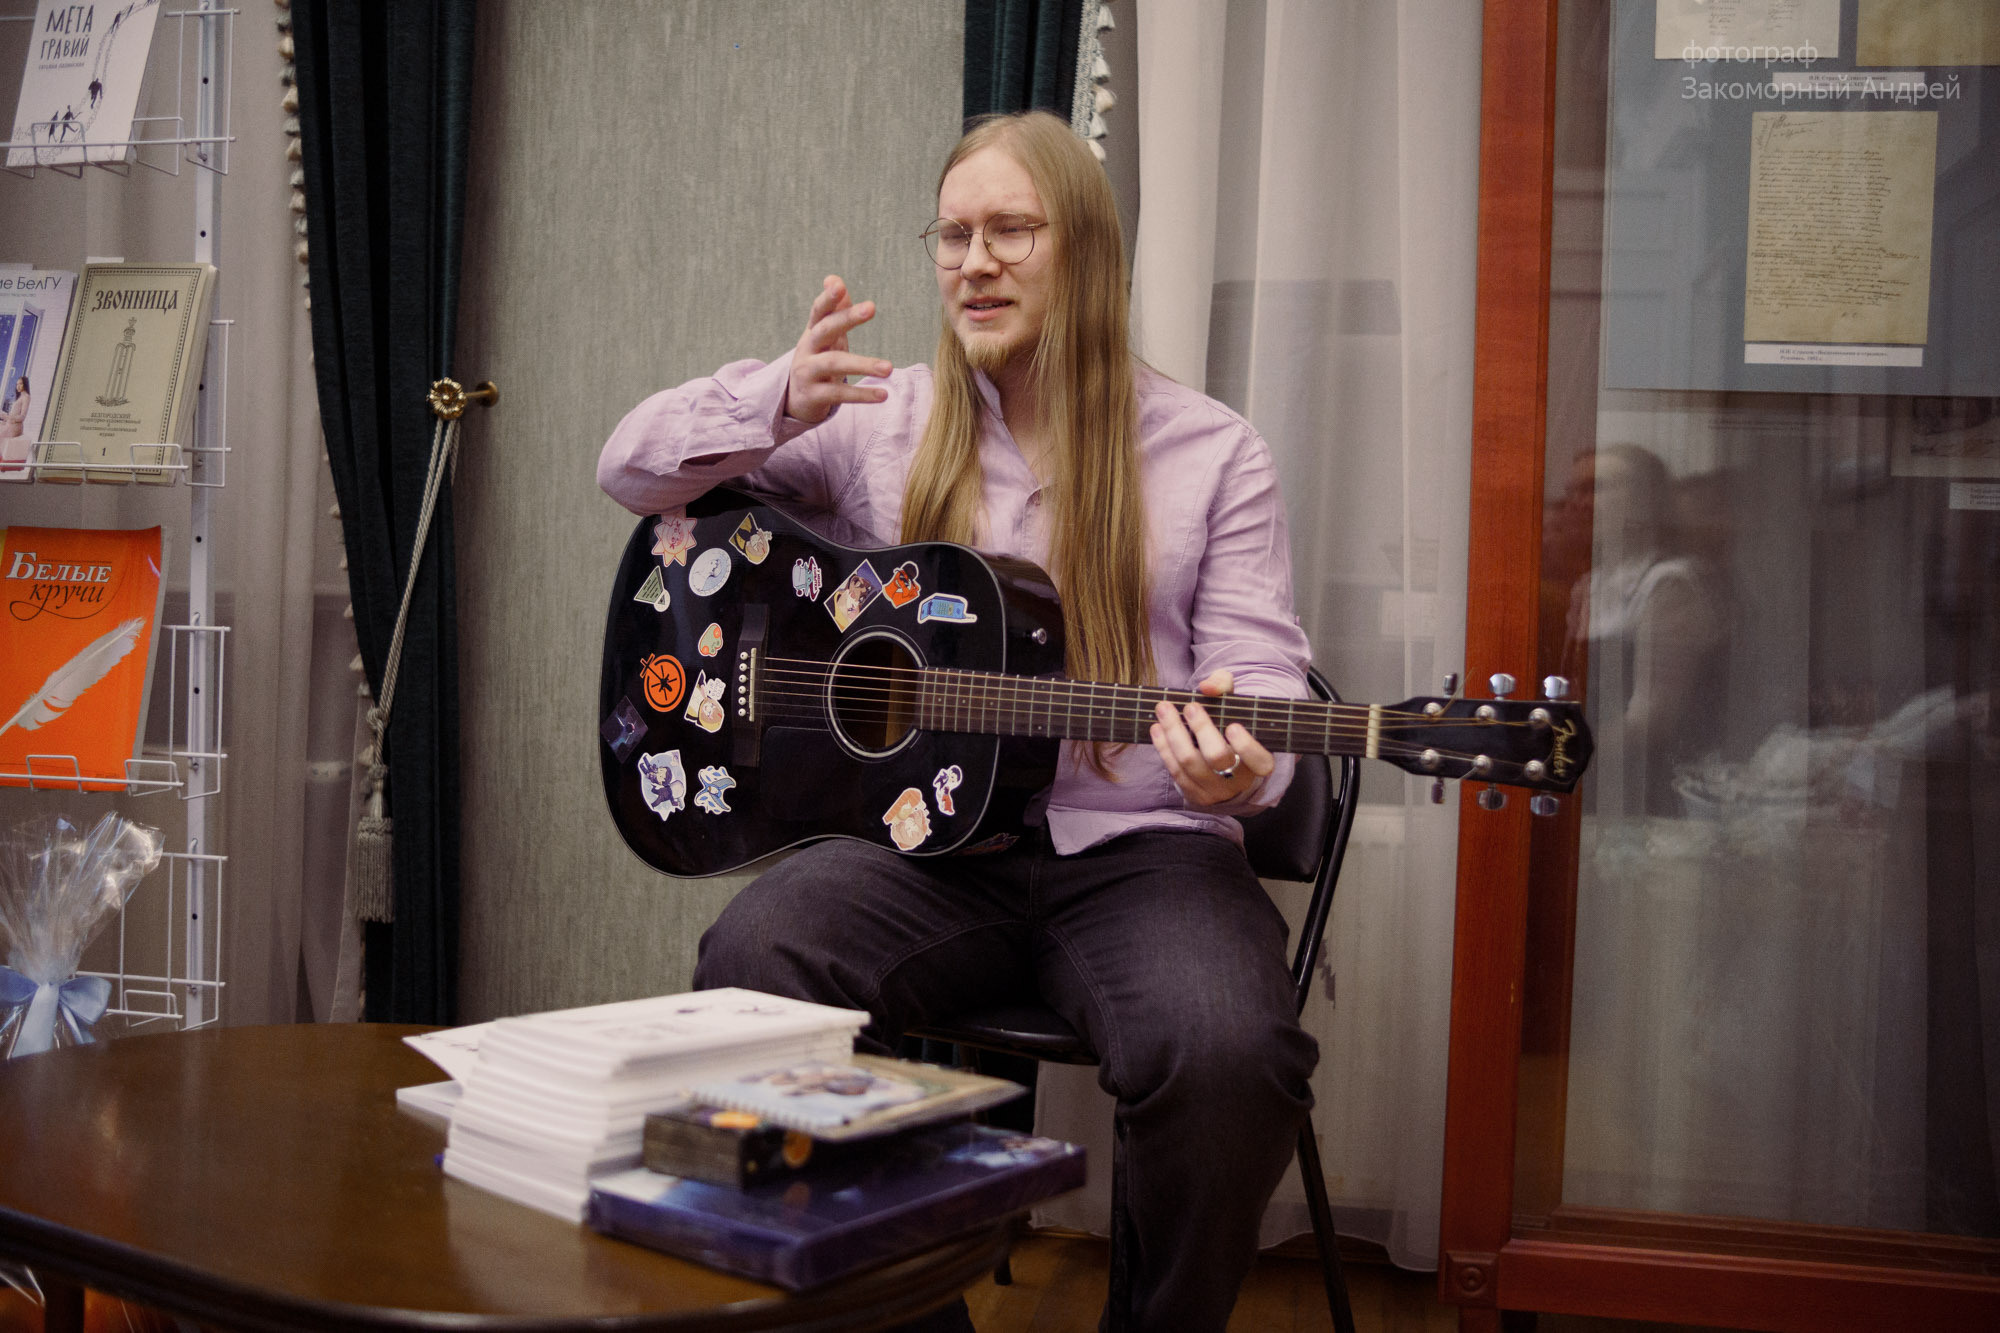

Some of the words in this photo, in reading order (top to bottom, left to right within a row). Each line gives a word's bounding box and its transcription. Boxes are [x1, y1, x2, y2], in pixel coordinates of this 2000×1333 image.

[46, 5, 94, 34] МЕТА
[40, 34, 90, 60] ГРАВИЙ
[16, 276, 62, 290] БелГУ
[92, 290, 180, 315] ЗВОННИЦА
[102, 447, 107, 457] 1
[1553, 719, 1577, 777] Fender
